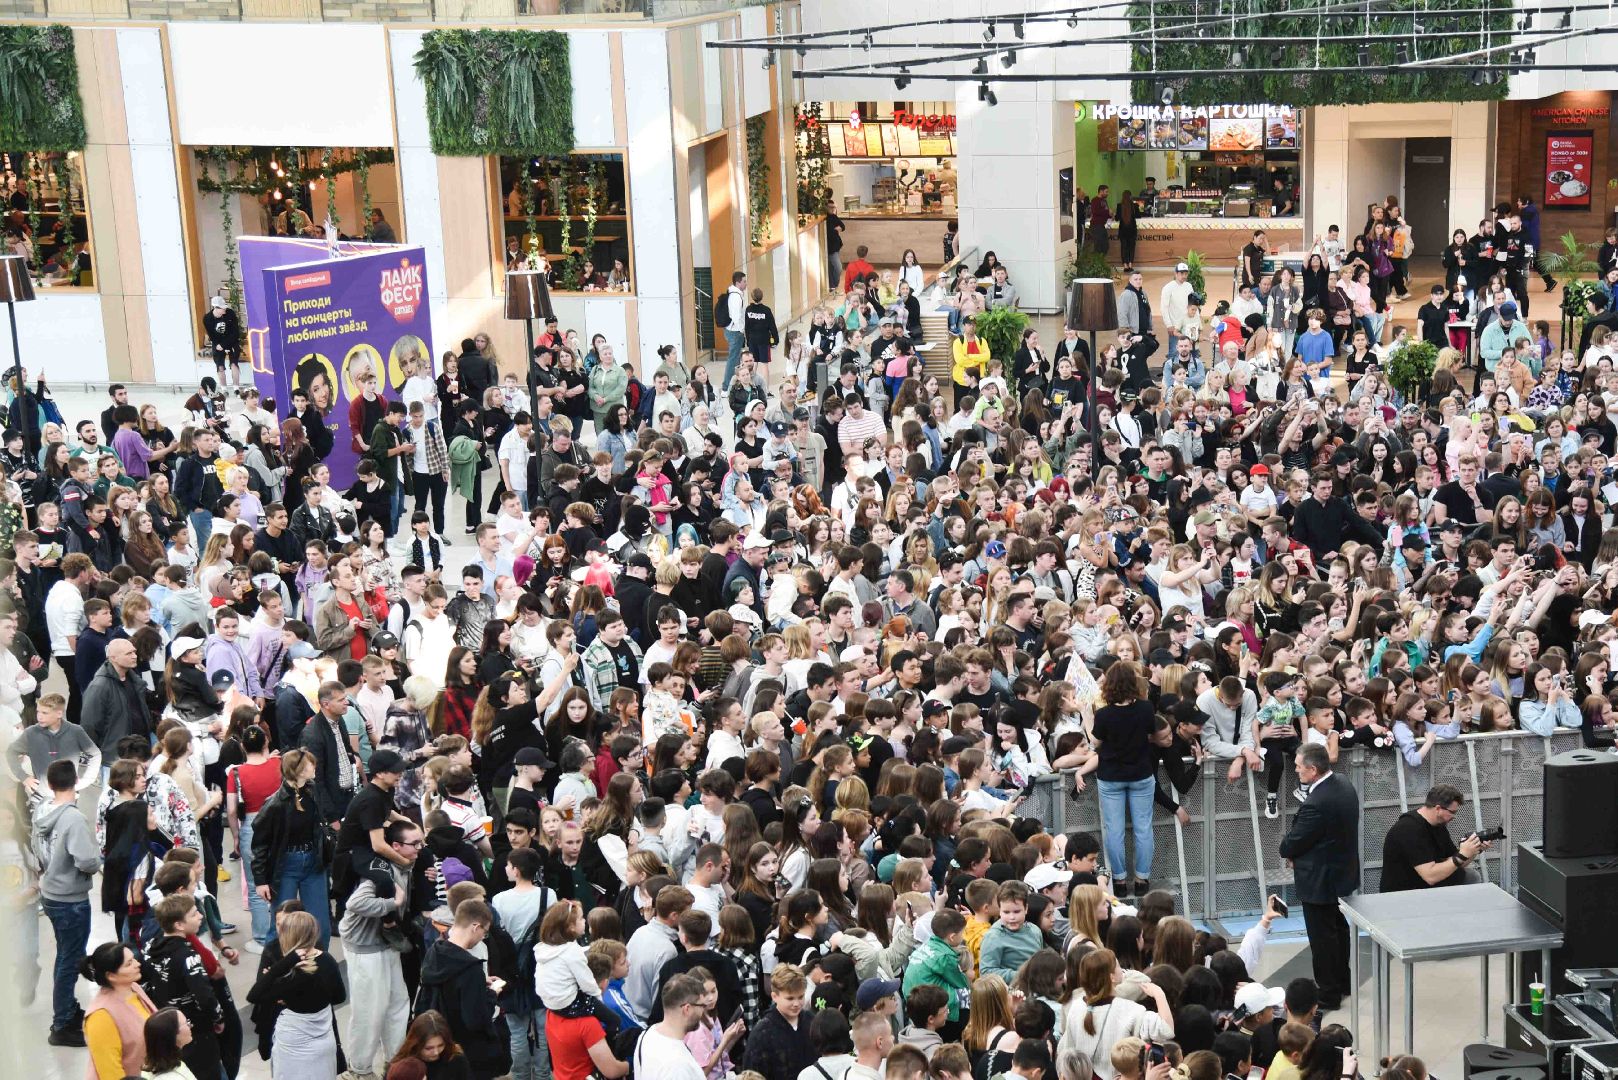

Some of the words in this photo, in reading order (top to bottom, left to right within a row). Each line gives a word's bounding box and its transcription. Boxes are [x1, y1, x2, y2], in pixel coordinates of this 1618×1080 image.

[1092, 104, 1175, 119] КРОШКА
[1180, 104, 1292, 119] КАРТОШКА
[1531, 107, 1572, 116] AMERICAN
[1575, 107, 1609, 115] CHINESE
[1136, 232, 1174, 242] ачестве!
[381, 283, 422, 305] ФЕСТ
[283, 296, 331, 314] Приходи
[285, 317, 299, 328] на
[301, 308, 352, 323] концерты
[287, 327, 337, 344] любимых
[338, 320, 368, 334] звёзд
